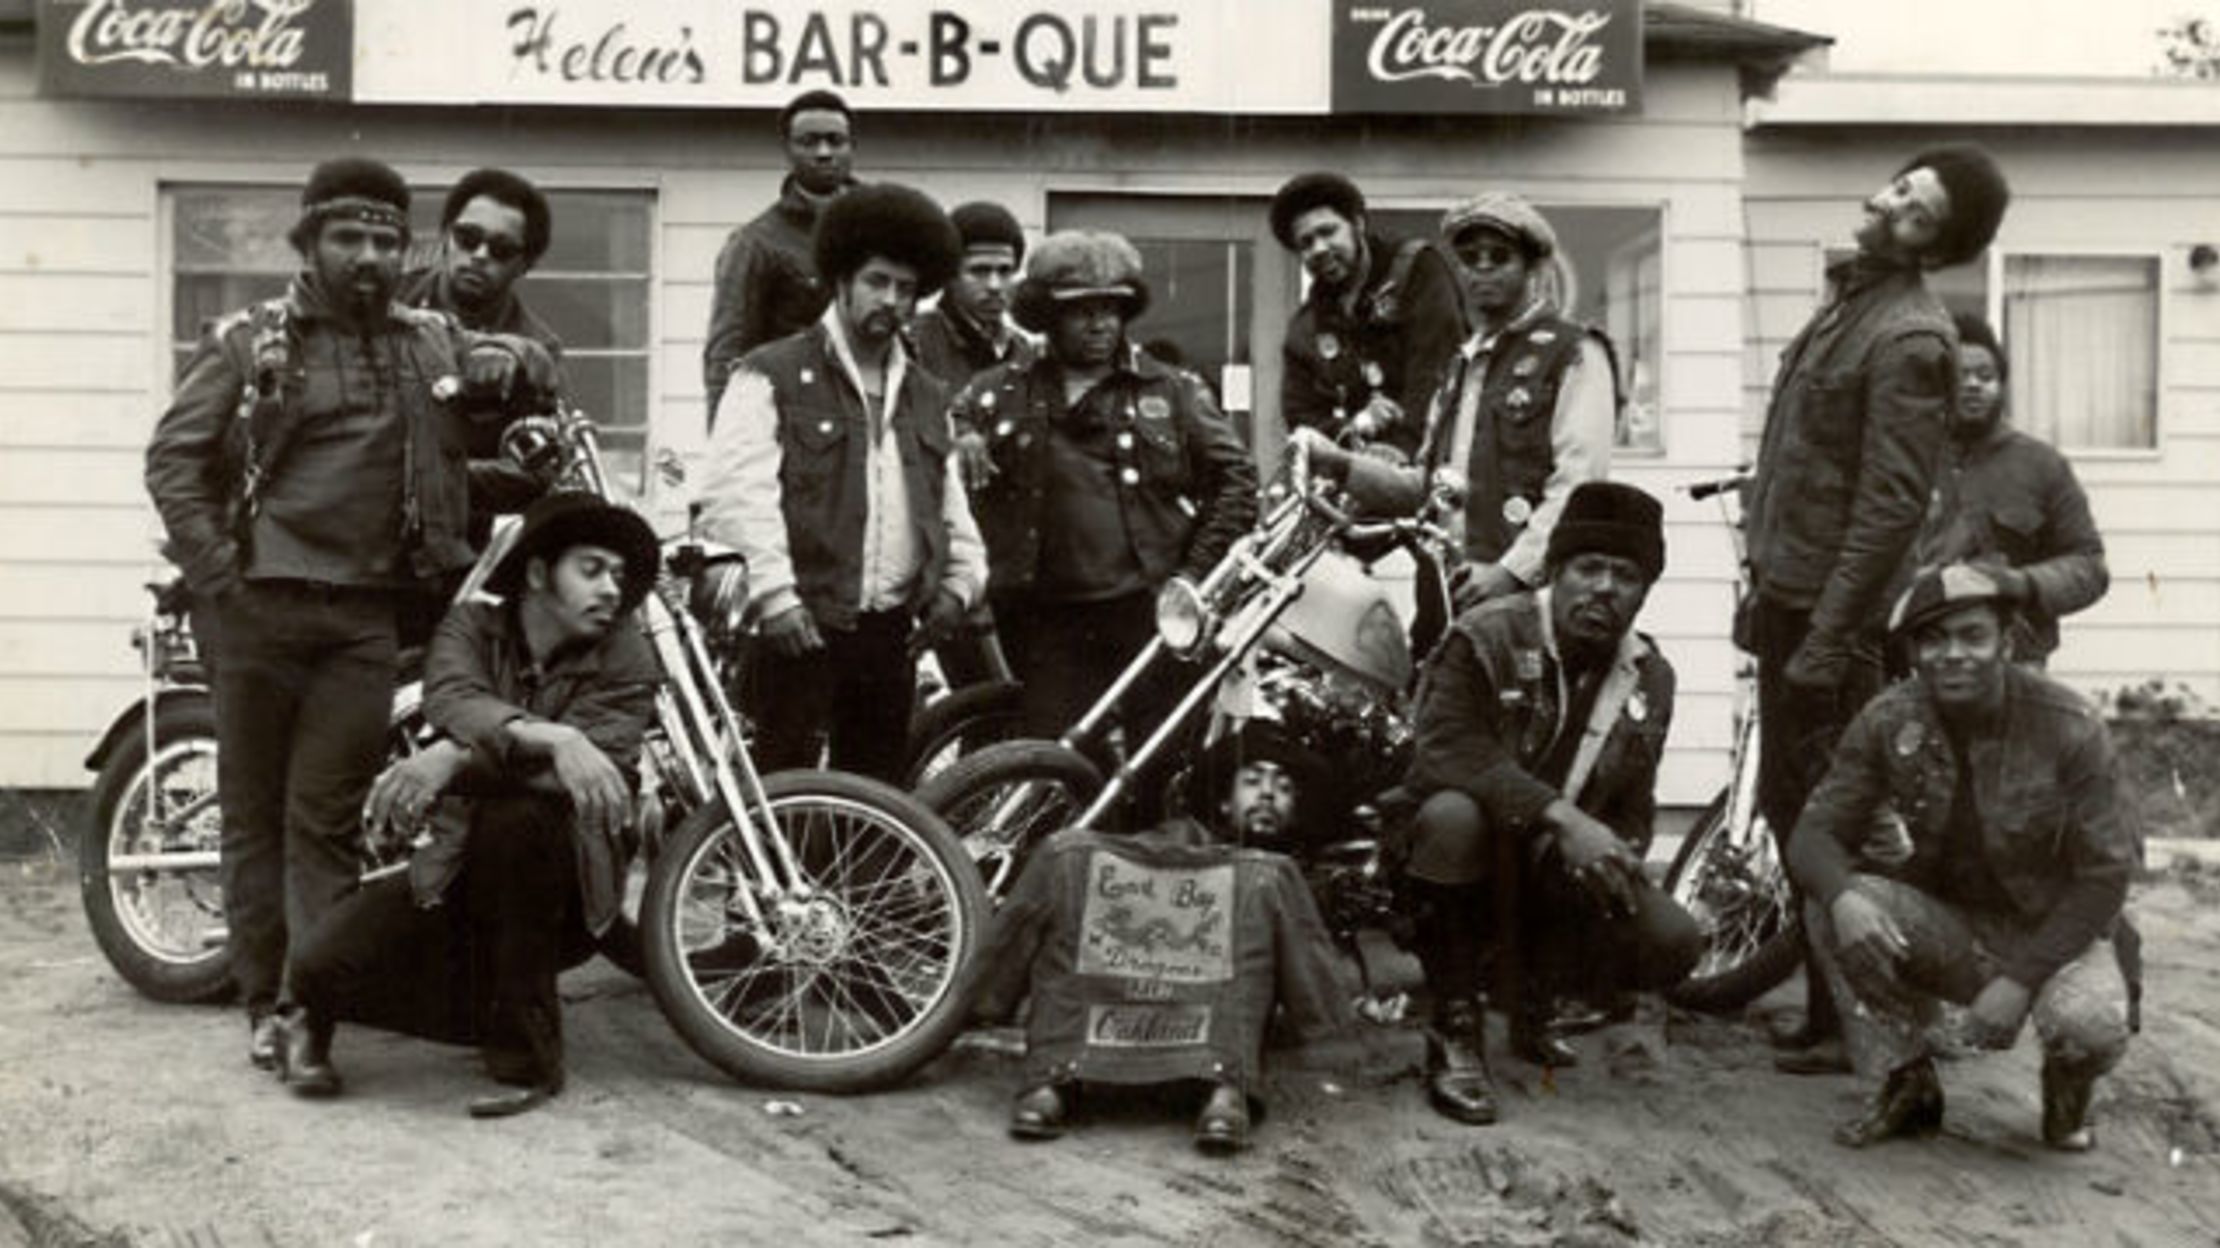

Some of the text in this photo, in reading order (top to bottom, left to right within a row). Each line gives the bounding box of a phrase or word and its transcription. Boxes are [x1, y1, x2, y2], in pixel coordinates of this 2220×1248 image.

[67, 0, 312, 68] Coca-Cola
[506, 8, 1179, 93] Helen's BAR-B-QUE
[1367, 9, 1612, 84] Coca-Cola
[261, 72, 329, 91] BOTTLES
[1558, 89, 1627, 106] BOTTLES
[1172, 878, 1216, 919] Bay
[1095, 1008, 1205, 1041] Oakland
